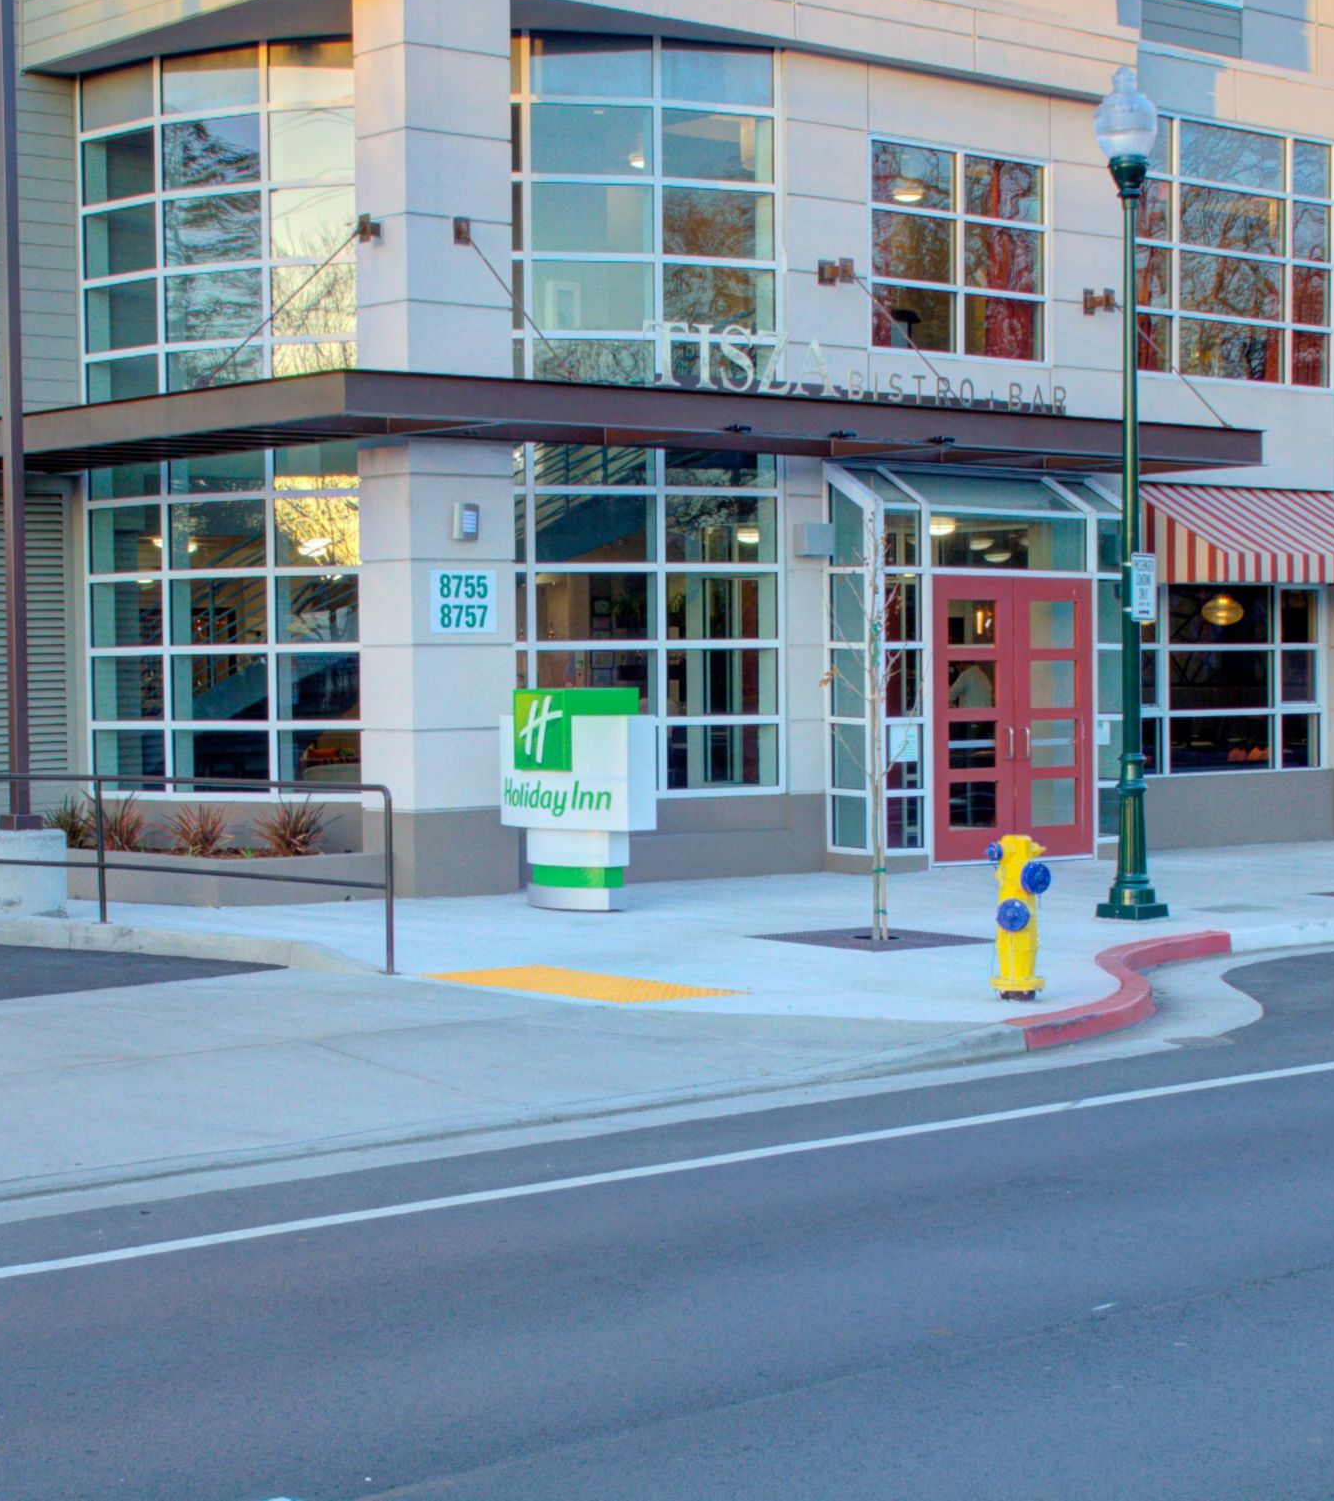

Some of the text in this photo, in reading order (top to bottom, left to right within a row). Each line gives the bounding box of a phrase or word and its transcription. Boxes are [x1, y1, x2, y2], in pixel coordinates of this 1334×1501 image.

[643, 319, 840, 398] TISZA
[848, 368, 975, 409] BISTRO
[1008, 382, 1067, 416] BAR
[439, 573, 488, 599] 8755
[440, 603, 488, 628] 8757
[504, 777, 613, 817] Holiday Inn
